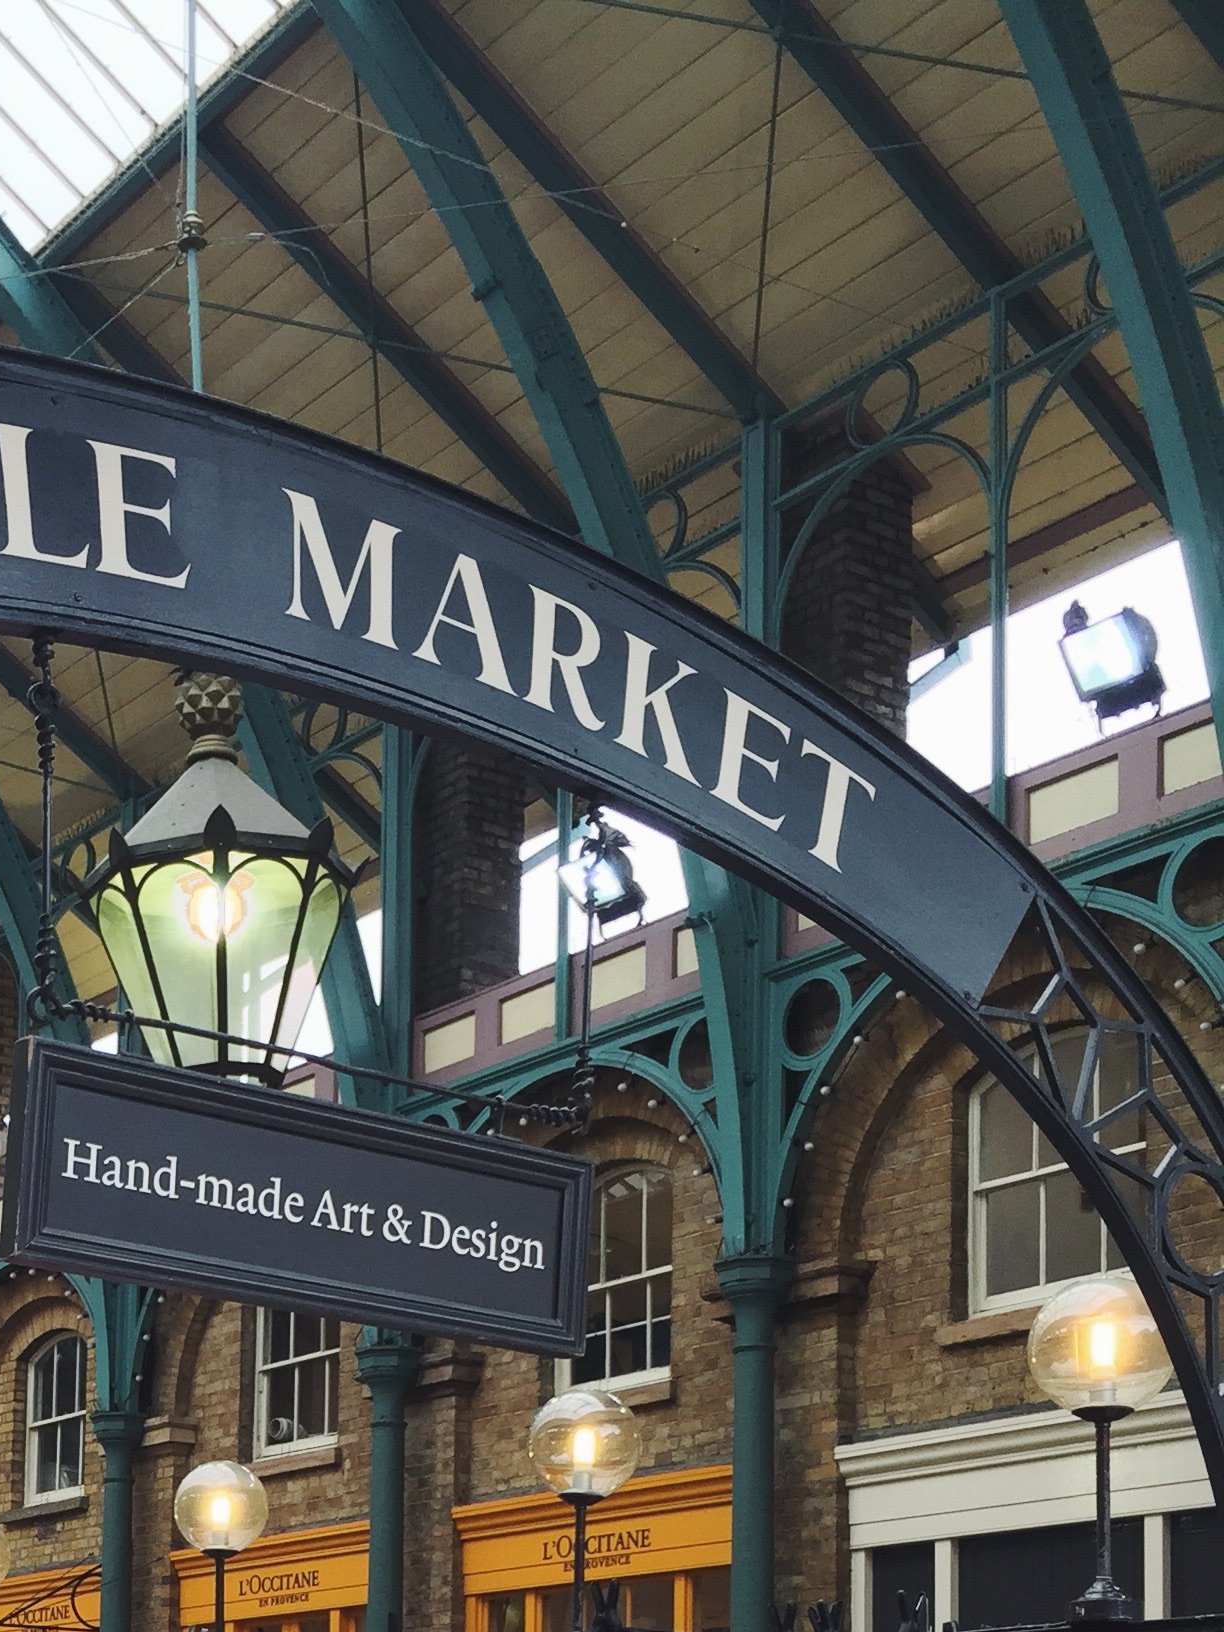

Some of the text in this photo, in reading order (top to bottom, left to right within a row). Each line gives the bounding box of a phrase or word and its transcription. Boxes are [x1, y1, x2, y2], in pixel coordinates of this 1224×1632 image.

[281, 487, 876, 874] MARKET
[61, 1137, 545, 1273] Hand-made Art & Design
[542, 1528, 651, 1560] L'OCITANE
[581, 1555, 631, 1569] ROVENCE
[239, 1570, 320, 1596] L'OCCITANE
[259, 1592, 309, 1607] EN PROVENCE
